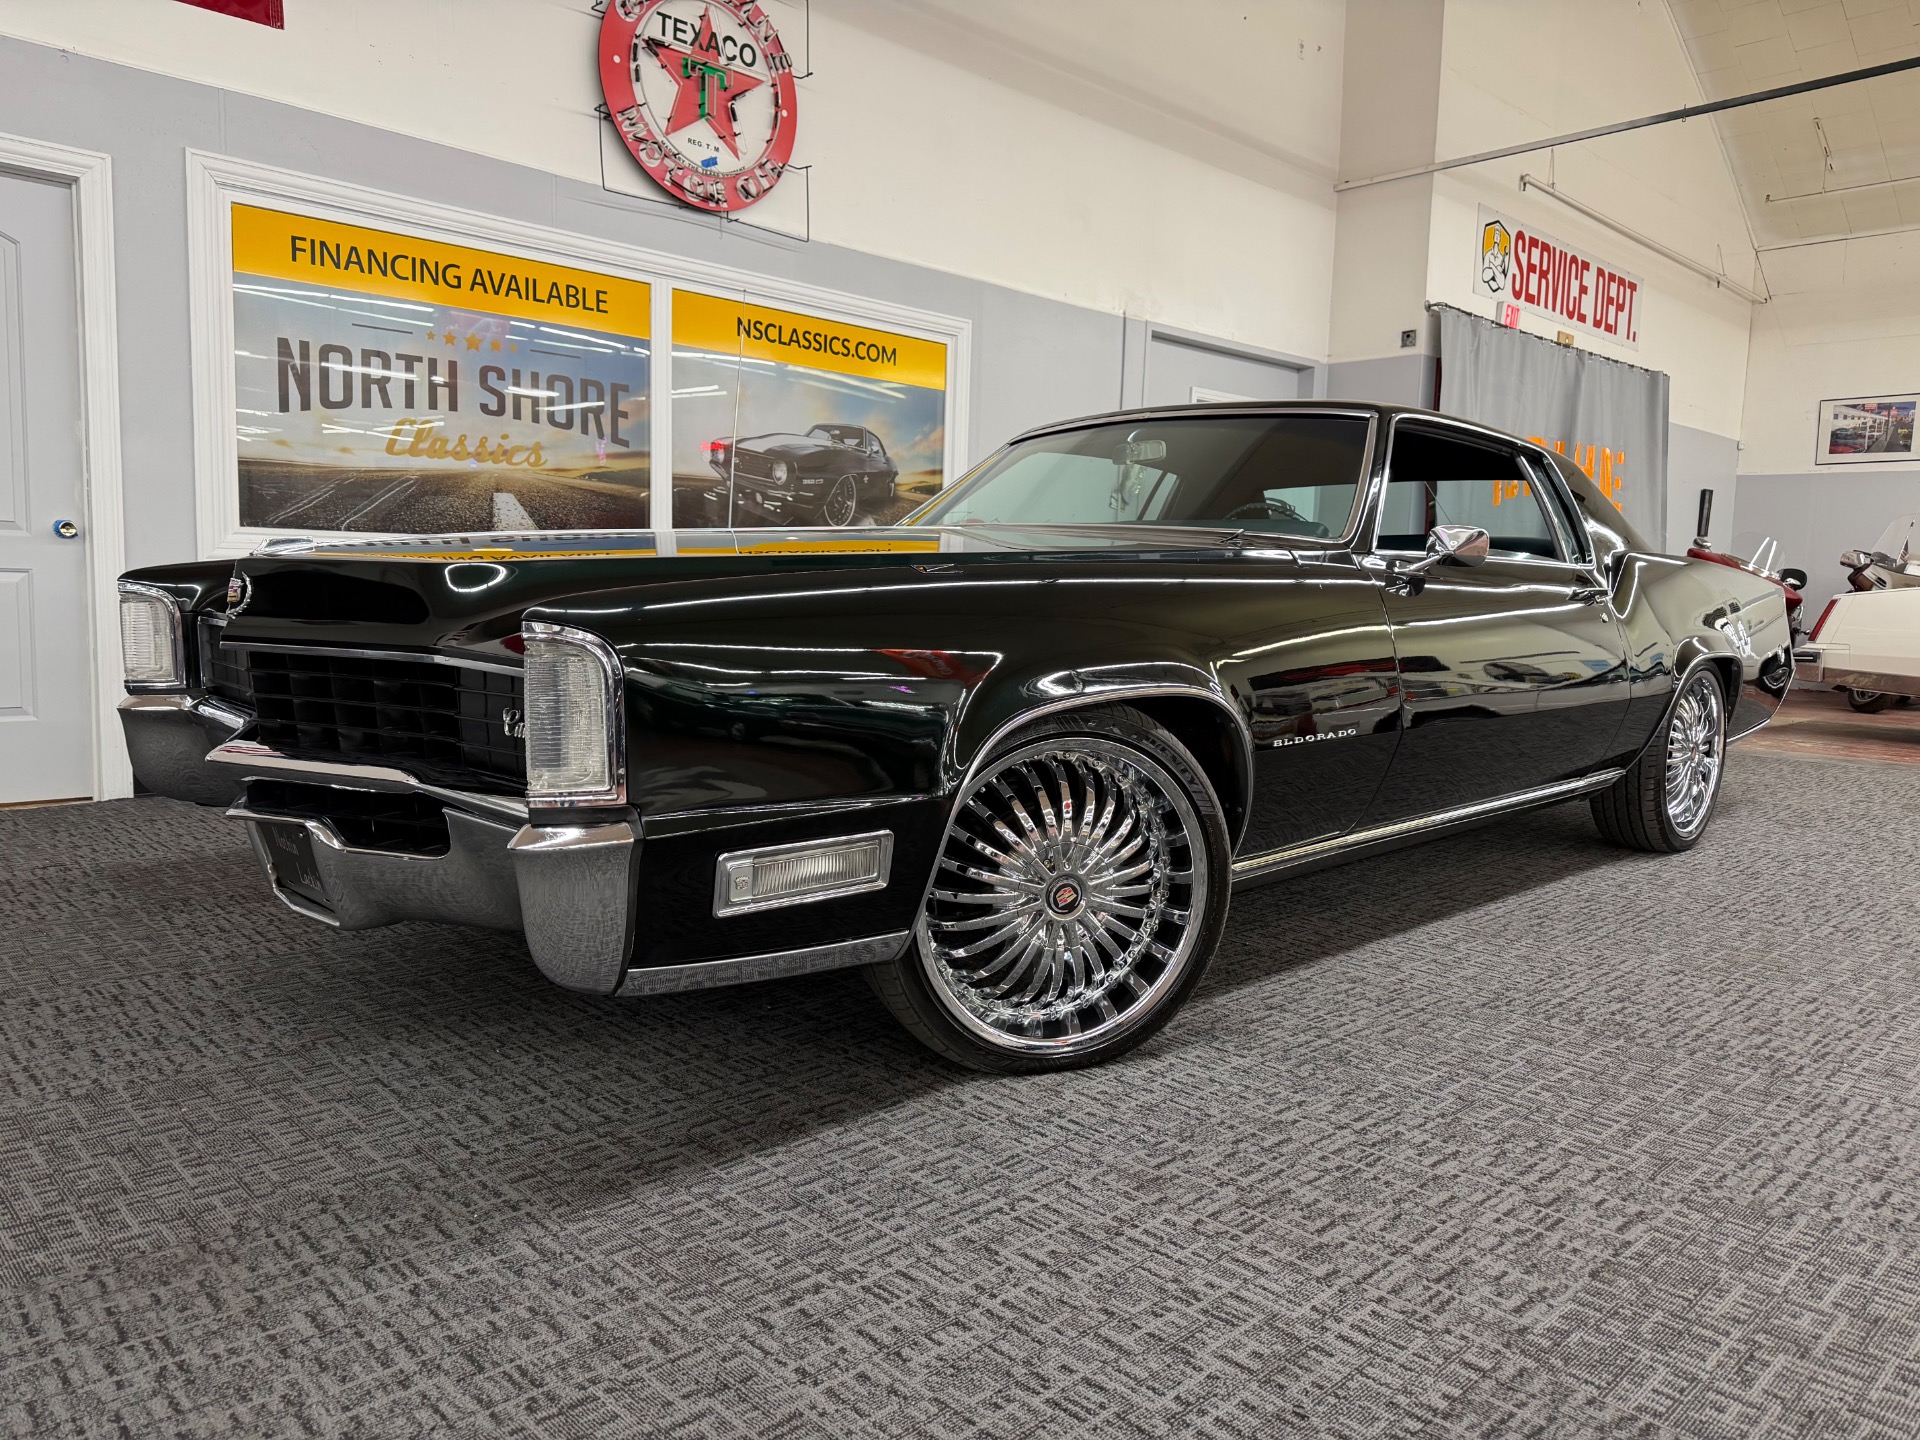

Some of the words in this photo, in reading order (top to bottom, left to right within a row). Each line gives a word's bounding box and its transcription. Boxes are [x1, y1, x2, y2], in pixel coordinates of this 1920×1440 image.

[656, 11, 757, 68] TEXACO
[290, 235, 461, 289] FINANCING
[469, 268, 608, 314] AVAILABLE
[1511, 229, 1591, 324] SERVICE
[1592, 265, 1638, 343] DEPT.
[736, 316, 898, 366] NSCLASSICS.COM
[276, 336, 459, 414] NORTH
[479, 364, 631, 449] SHORE
[384, 417, 548, 468] Classics
[1272, 728, 1357, 747] ELDORADO
